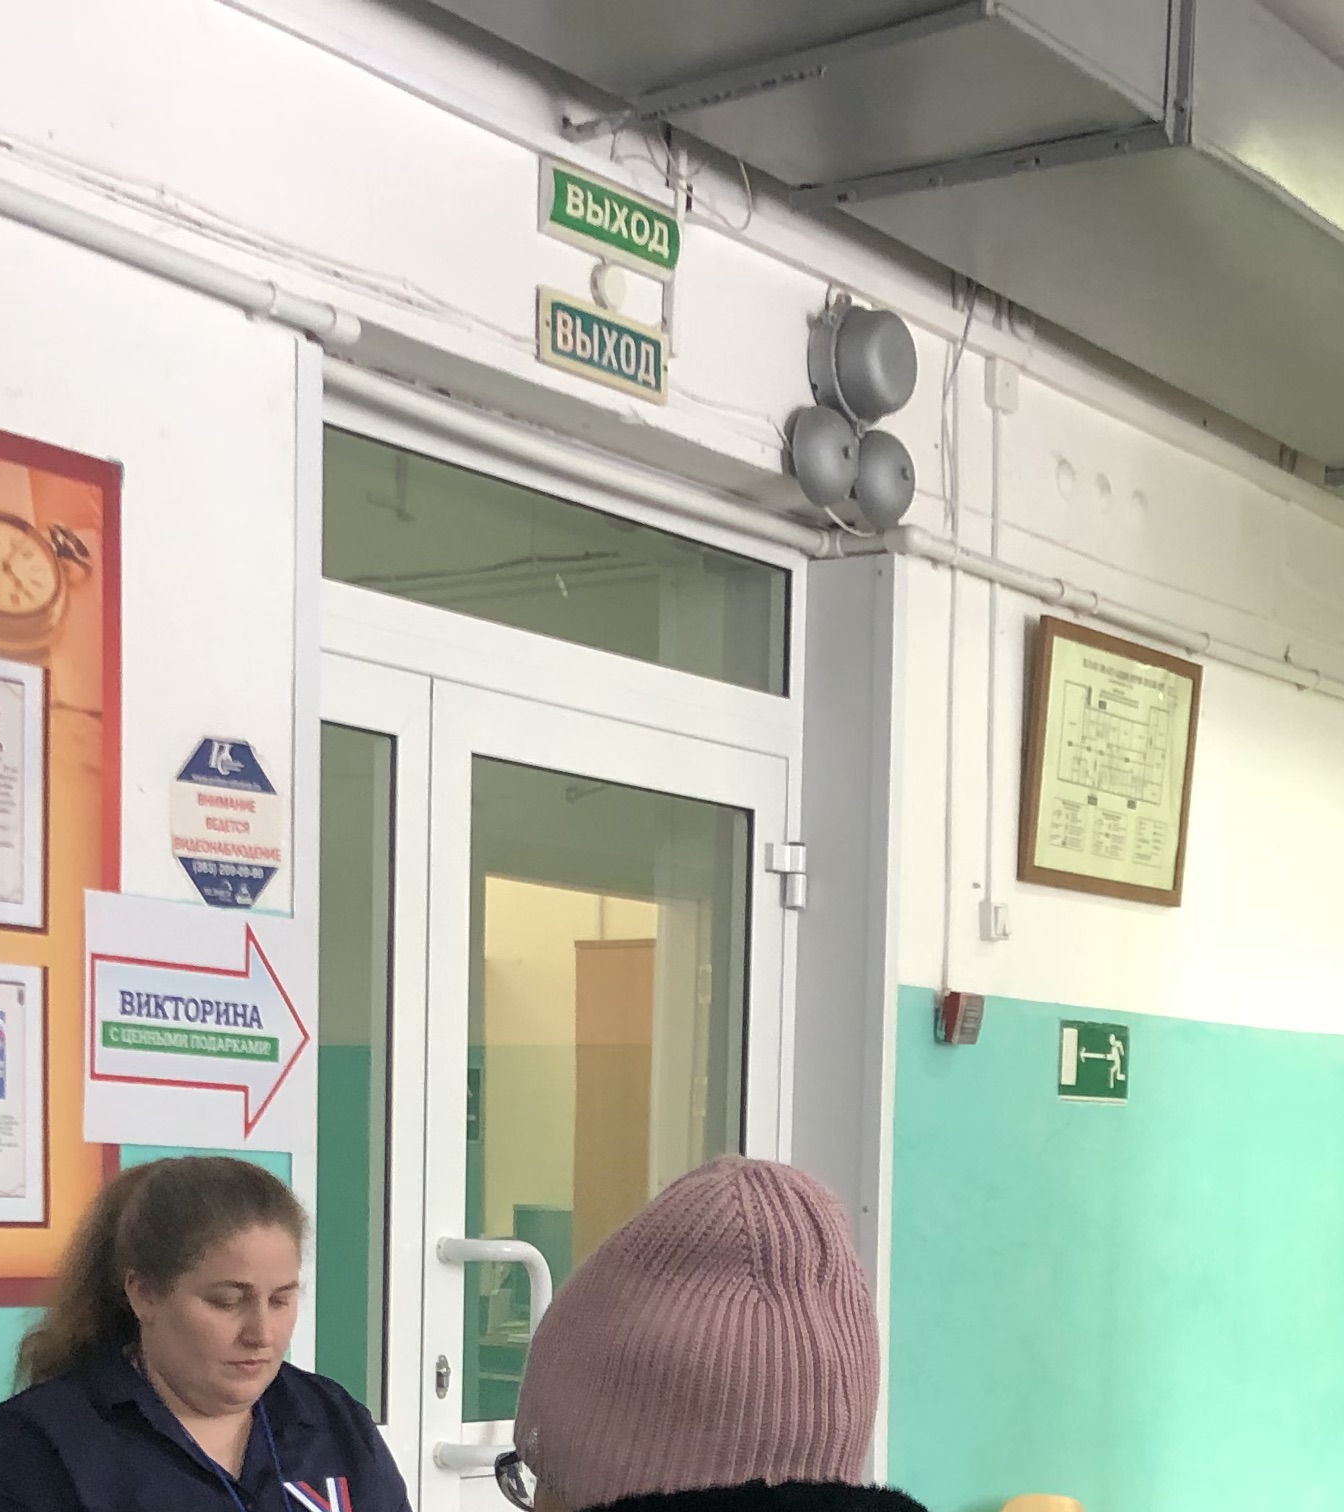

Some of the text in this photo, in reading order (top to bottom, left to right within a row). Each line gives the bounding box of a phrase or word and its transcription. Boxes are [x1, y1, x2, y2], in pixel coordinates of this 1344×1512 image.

[565, 181, 671, 260] ВЫХОД
[556, 308, 657, 388] ВЫХОД
[196, 791, 257, 814] ВНИМАНИЕ
[205, 815, 251, 835] ВЕДЕТСЯ
[170, 833, 282, 863] ВИДЕОНАБЛЮДЕНИЕ
[118, 988, 265, 1031] ВИКТОРИНА
[108, 1026, 273, 1057] С ЦЕННЫМИ ПОДАРКАМИ!
